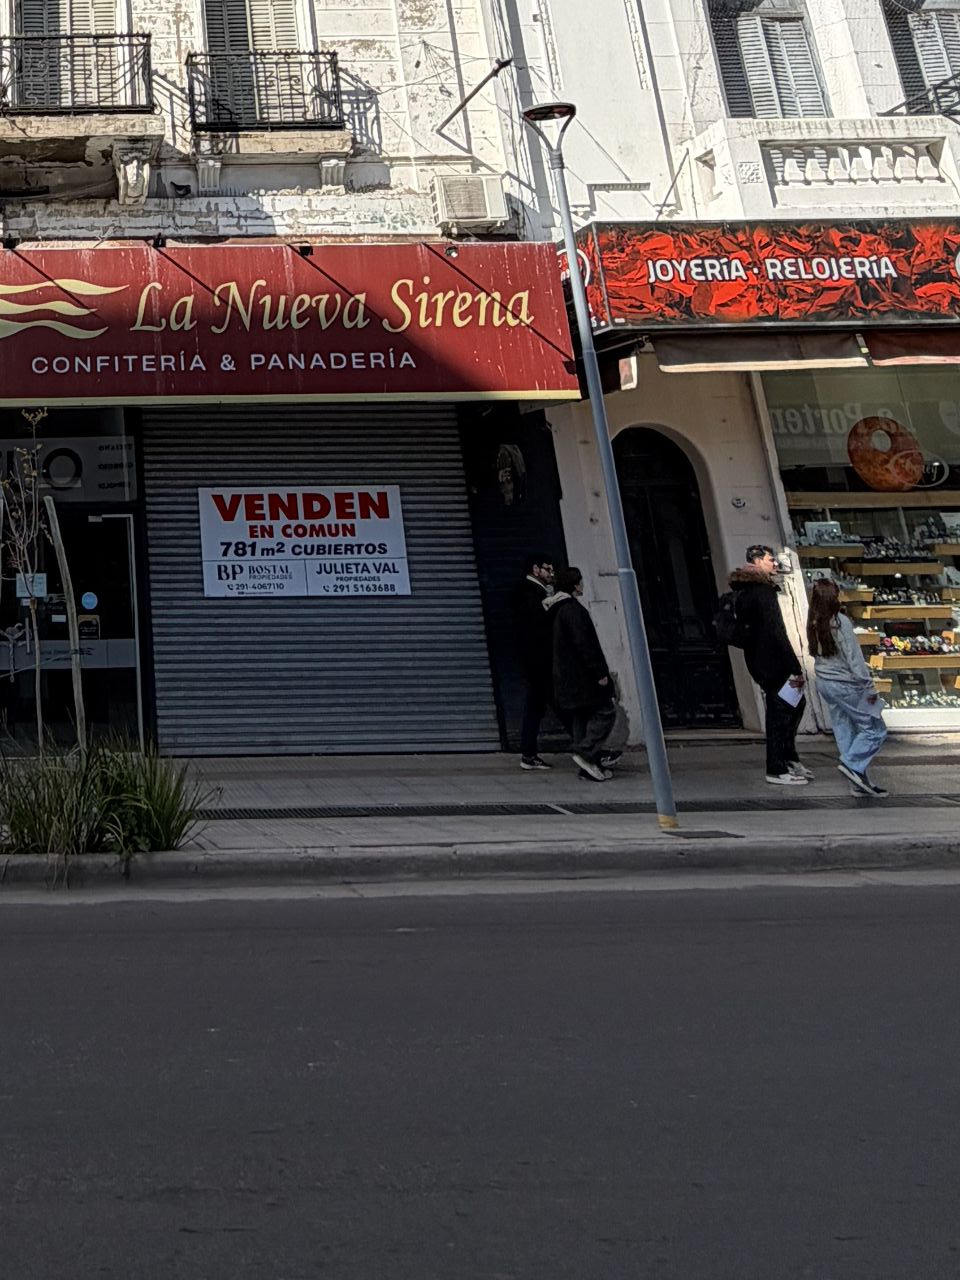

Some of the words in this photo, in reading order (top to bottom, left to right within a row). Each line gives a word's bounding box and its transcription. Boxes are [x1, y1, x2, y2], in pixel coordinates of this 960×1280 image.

[129, 281, 198, 332] La
[210, 279, 371, 334] Nueva
[382, 276, 535, 333] Sirena
[31, 350, 207, 373] CONFITERÍA
[220, 354, 237, 371] &
[250, 347, 416, 370] PANADERÍA
[211, 492, 390, 521] VENDEN
[248, 524, 274, 538] EN
[281, 523, 356, 538] COMUN
[220, 542, 257, 557] 781
[291, 543, 388, 556] CUBIERTOS
[217, 564, 244, 580] BP
[316, 562, 371, 574] JULIETA
[372, 562, 399, 574] VAL
[333, 584, 350, 592] 291
[353, 584, 396, 592] 5163688
